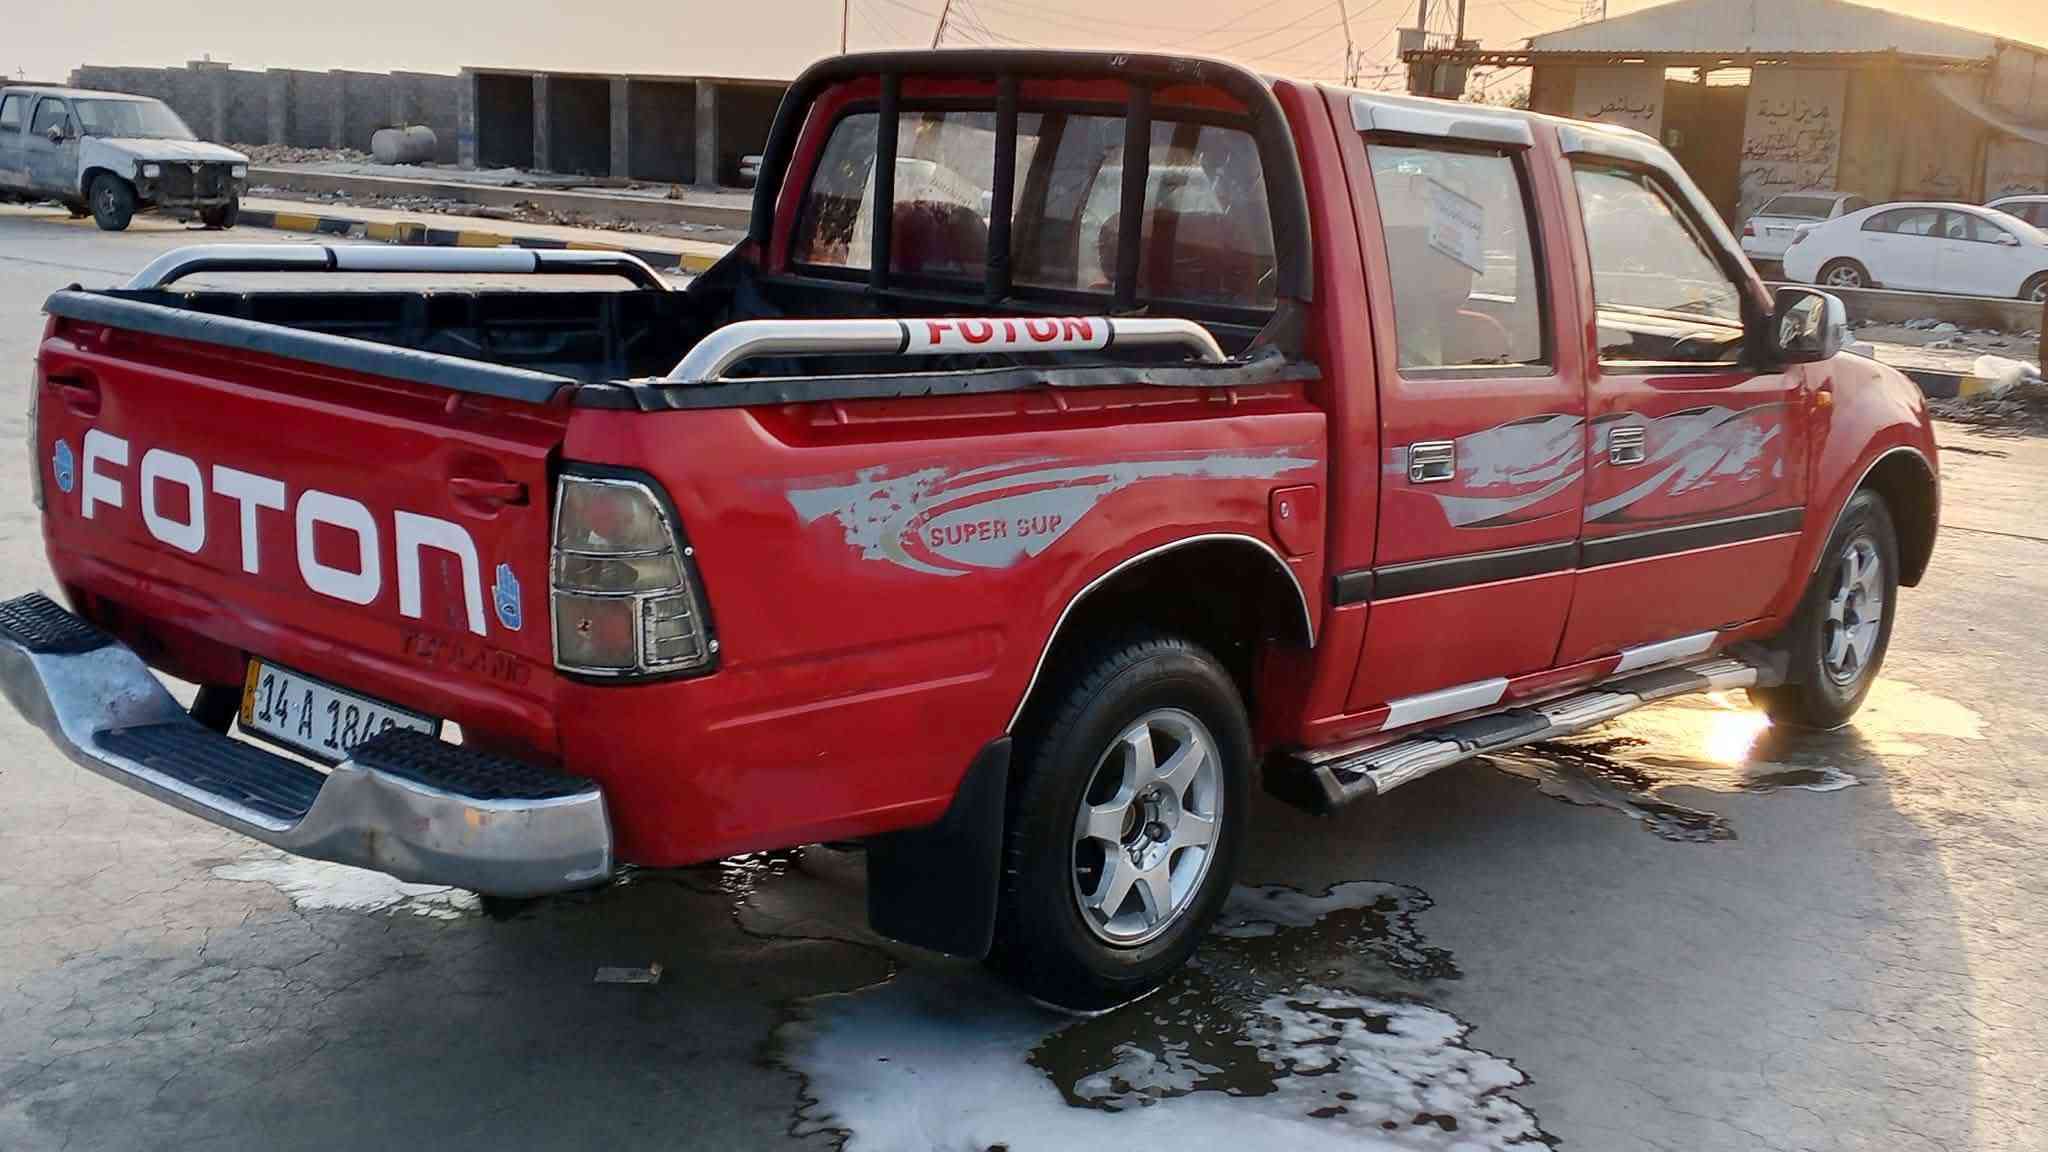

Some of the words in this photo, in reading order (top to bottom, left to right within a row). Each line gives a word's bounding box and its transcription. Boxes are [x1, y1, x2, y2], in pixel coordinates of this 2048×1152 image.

[81, 428, 488, 637] FOTON
[930, 519, 1008, 547] SUPER
[1016, 513, 1062, 537] SUP
[258, 671, 289, 729] 14
[298, 688, 313, 740] A
